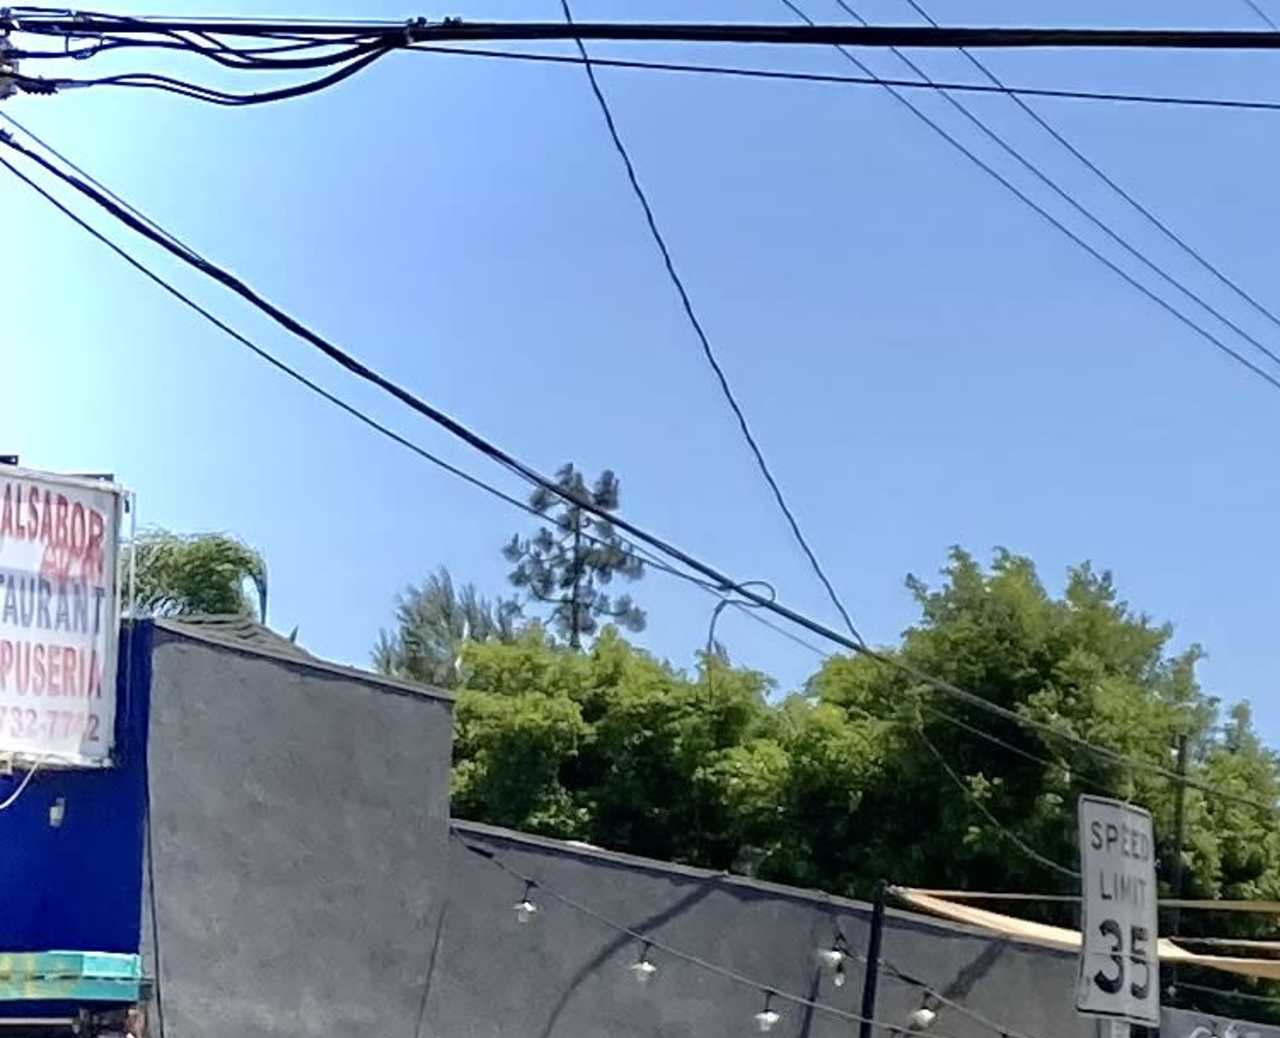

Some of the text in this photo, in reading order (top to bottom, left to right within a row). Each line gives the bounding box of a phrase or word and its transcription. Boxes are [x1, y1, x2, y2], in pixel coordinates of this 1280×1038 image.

[1091, 821, 1150, 860] SPEED
[1101, 868, 1147, 906] LIMIT
[1094, 919, 1149, 1000] 35
